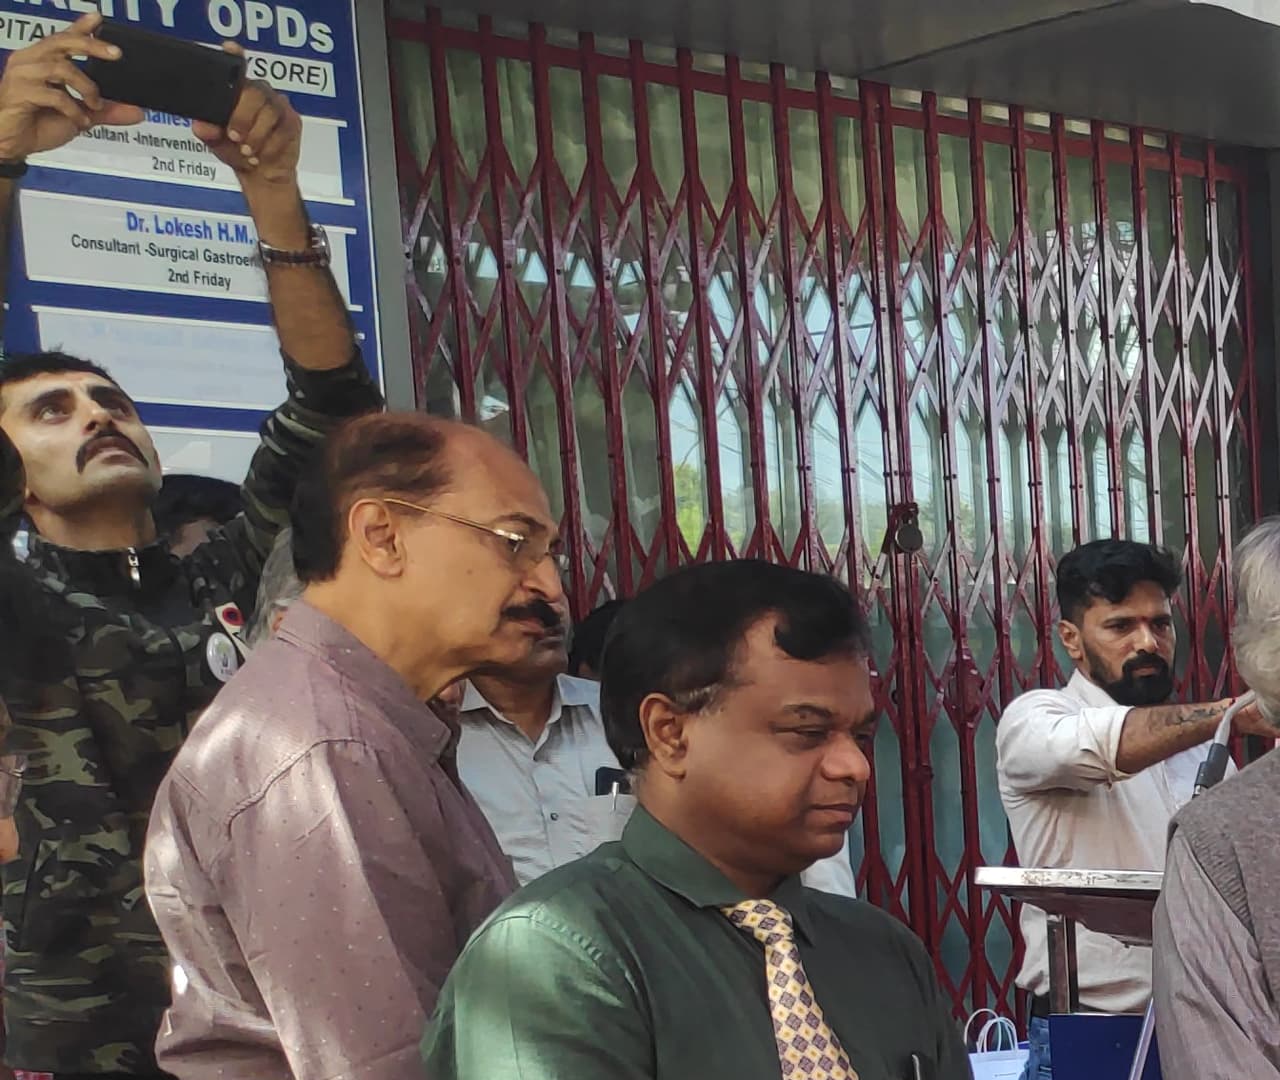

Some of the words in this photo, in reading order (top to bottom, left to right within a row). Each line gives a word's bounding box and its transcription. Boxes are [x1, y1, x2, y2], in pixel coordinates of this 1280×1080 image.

[208, 0, 334, 53] OPDs
[248, 57, 328, 91] SORE)
[152, 156, 175, 173] 2nd
[178, 159, 217, 181] Friday
[126, 211, 150, 233] Dr.
[154, 214, 213, 240] Lokesh
[71, 234, 141, 256] Consultant
[168, 268, 190, 284] 2nd
[193, 271, 231, 291] Friday
